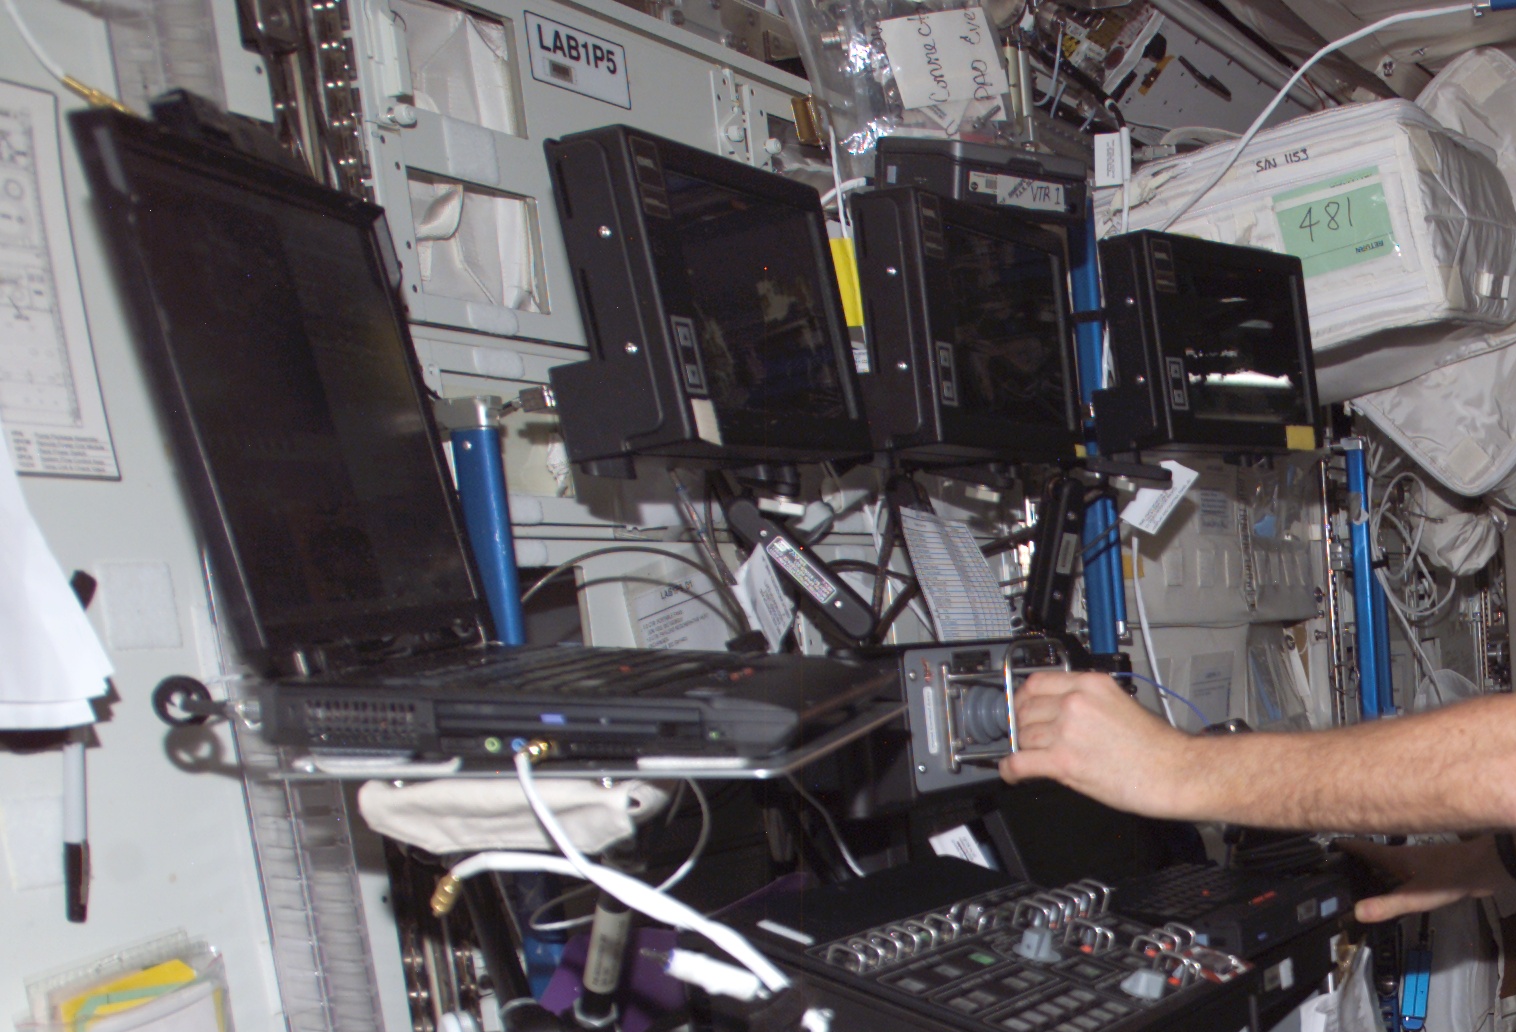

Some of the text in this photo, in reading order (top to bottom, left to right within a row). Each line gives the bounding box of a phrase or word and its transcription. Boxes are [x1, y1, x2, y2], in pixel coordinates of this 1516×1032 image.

[536, 23, 618, 75] LAB1P5
[1256, 148, 1310, 173] S/N 1153
[1030, 186, 1051, 203] VTR
[1299, 197, 1353, 242] 481
[1355, 239, 1385, 254] RETURN
